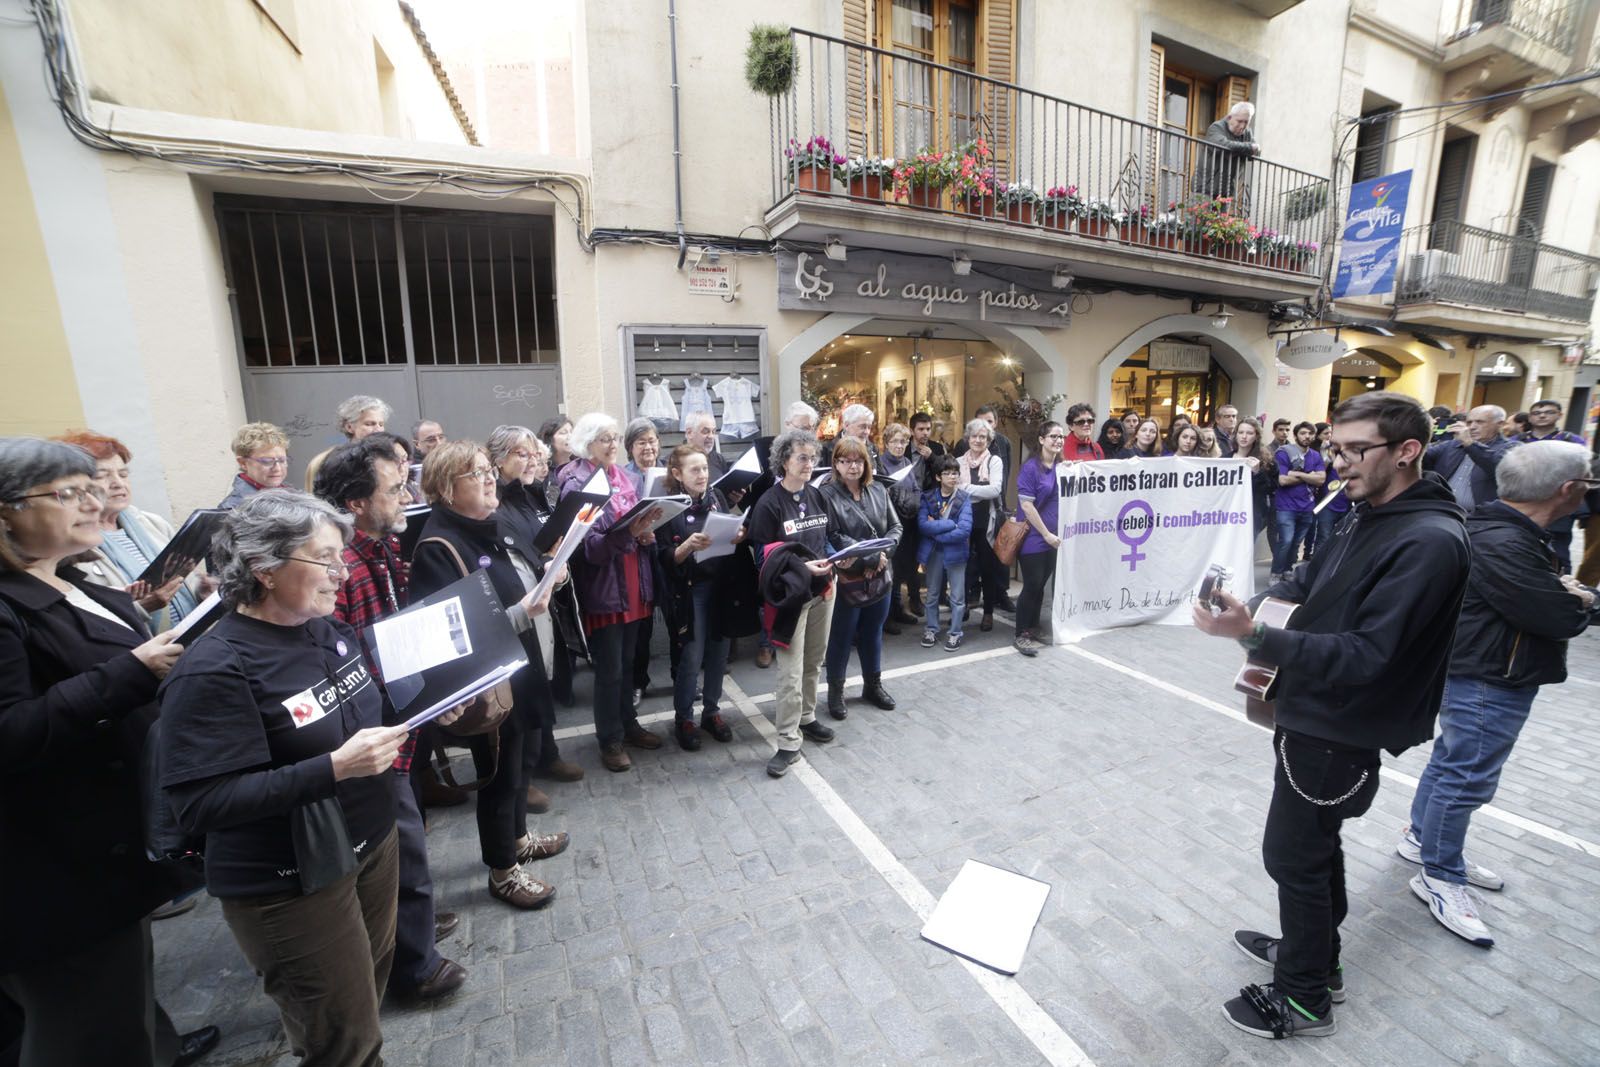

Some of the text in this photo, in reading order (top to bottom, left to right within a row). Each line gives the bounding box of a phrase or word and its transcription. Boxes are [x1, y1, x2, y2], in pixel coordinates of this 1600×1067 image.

[1368, 209, 1401, 229] Vila
[857, 264, 1042, 321] al agua patos
[1109, 473, 1137, 492] ens
[1138, 469, 1178, 490] faran
[1183, 465, 1244, 488] callar!
[1117, 514, 1154, 531] rebels
[1156, 512, 1160, 528] i
[1163, 509, 1248, 529] combatives
